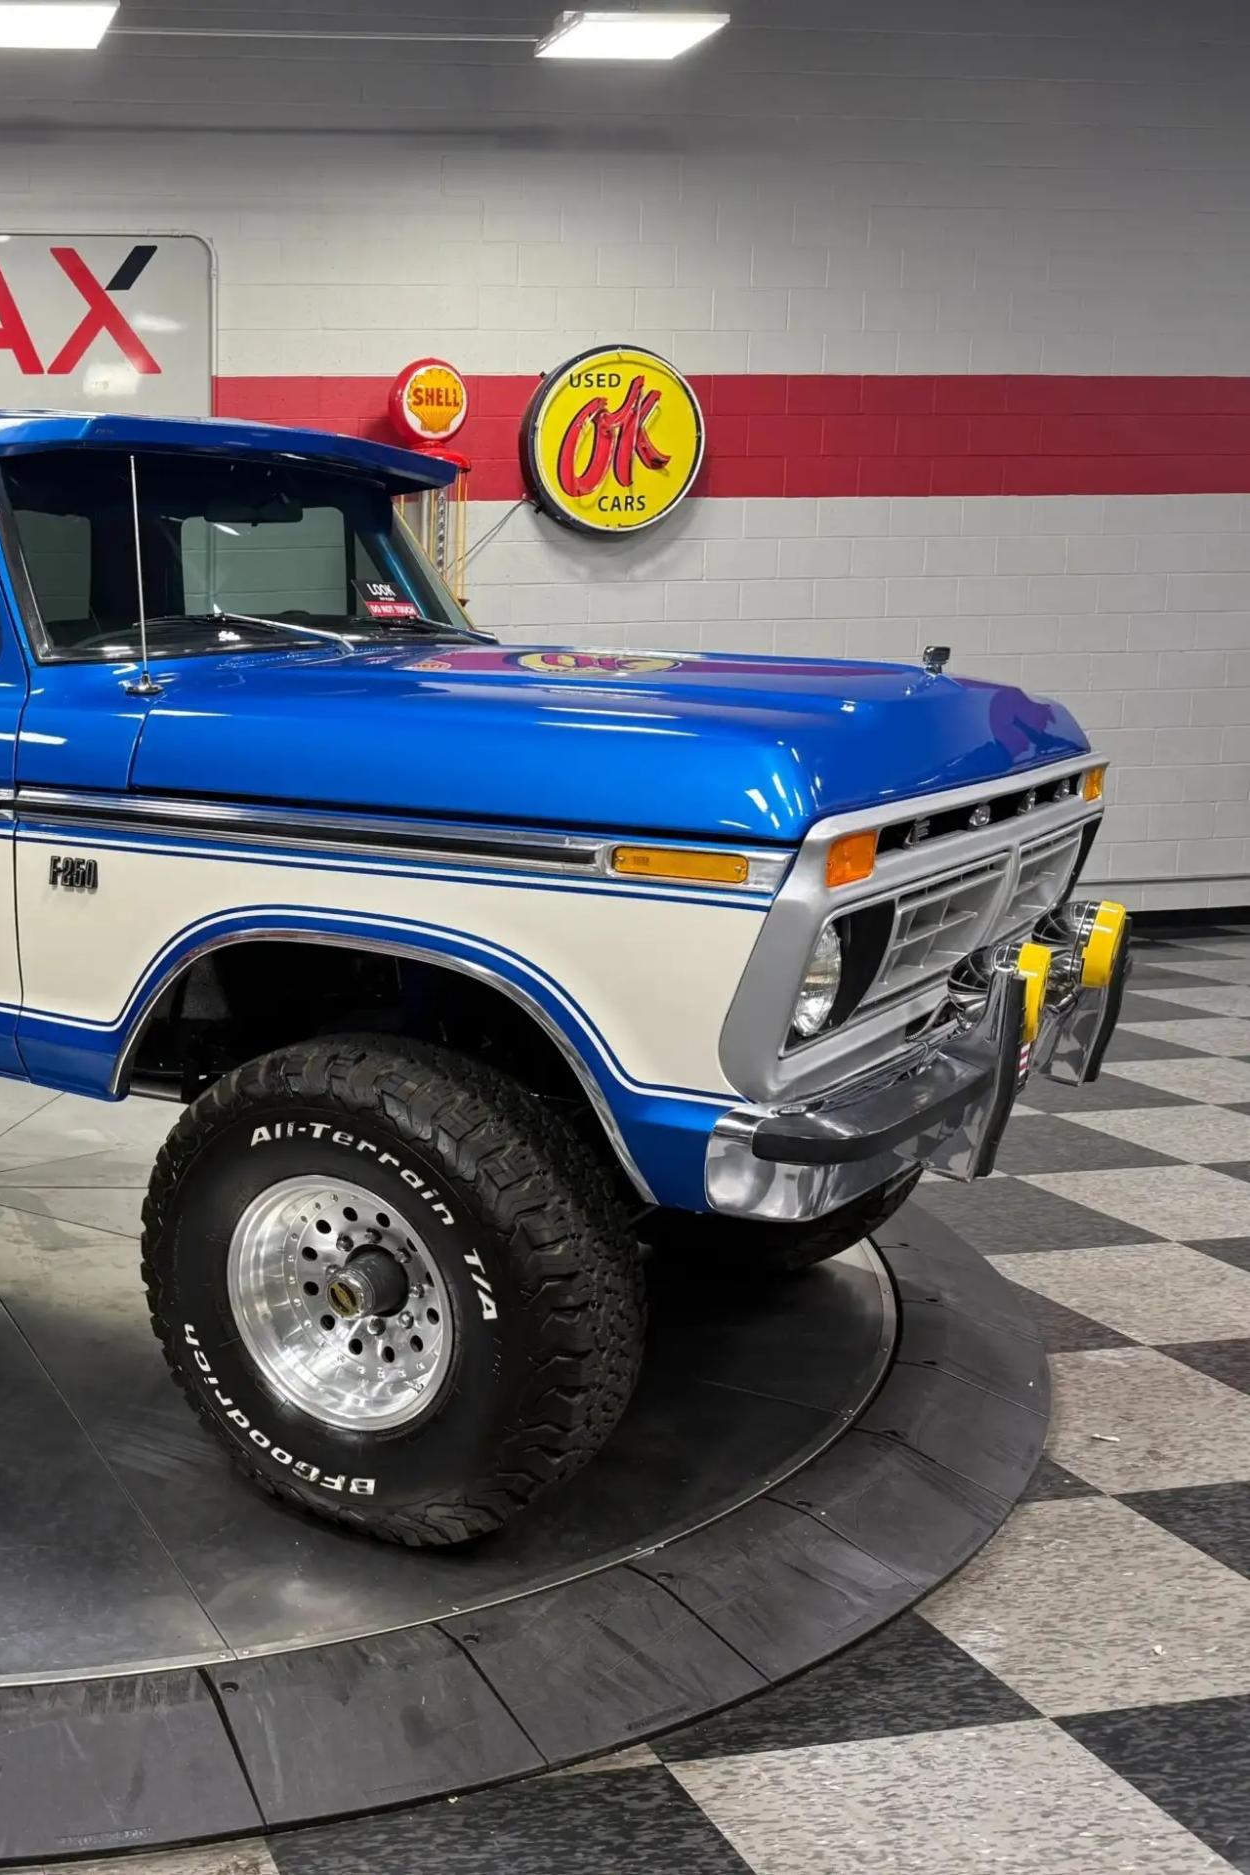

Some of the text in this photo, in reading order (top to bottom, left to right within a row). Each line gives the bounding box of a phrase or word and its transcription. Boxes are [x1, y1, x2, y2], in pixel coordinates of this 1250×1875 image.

[412, 387, 460, 408] SHELL
[569, 373, 621, 388] USED
[557, 375, 672, 498] OK
[597, 496, 646, 512] CARS
[366, 583, 396, 596] LOOK
[250, 1122, 455, 1226] All-Terrain
[463, 1248, 499, 1321] T/A
[183, 1323, 376, 1495] BFGoodrich
